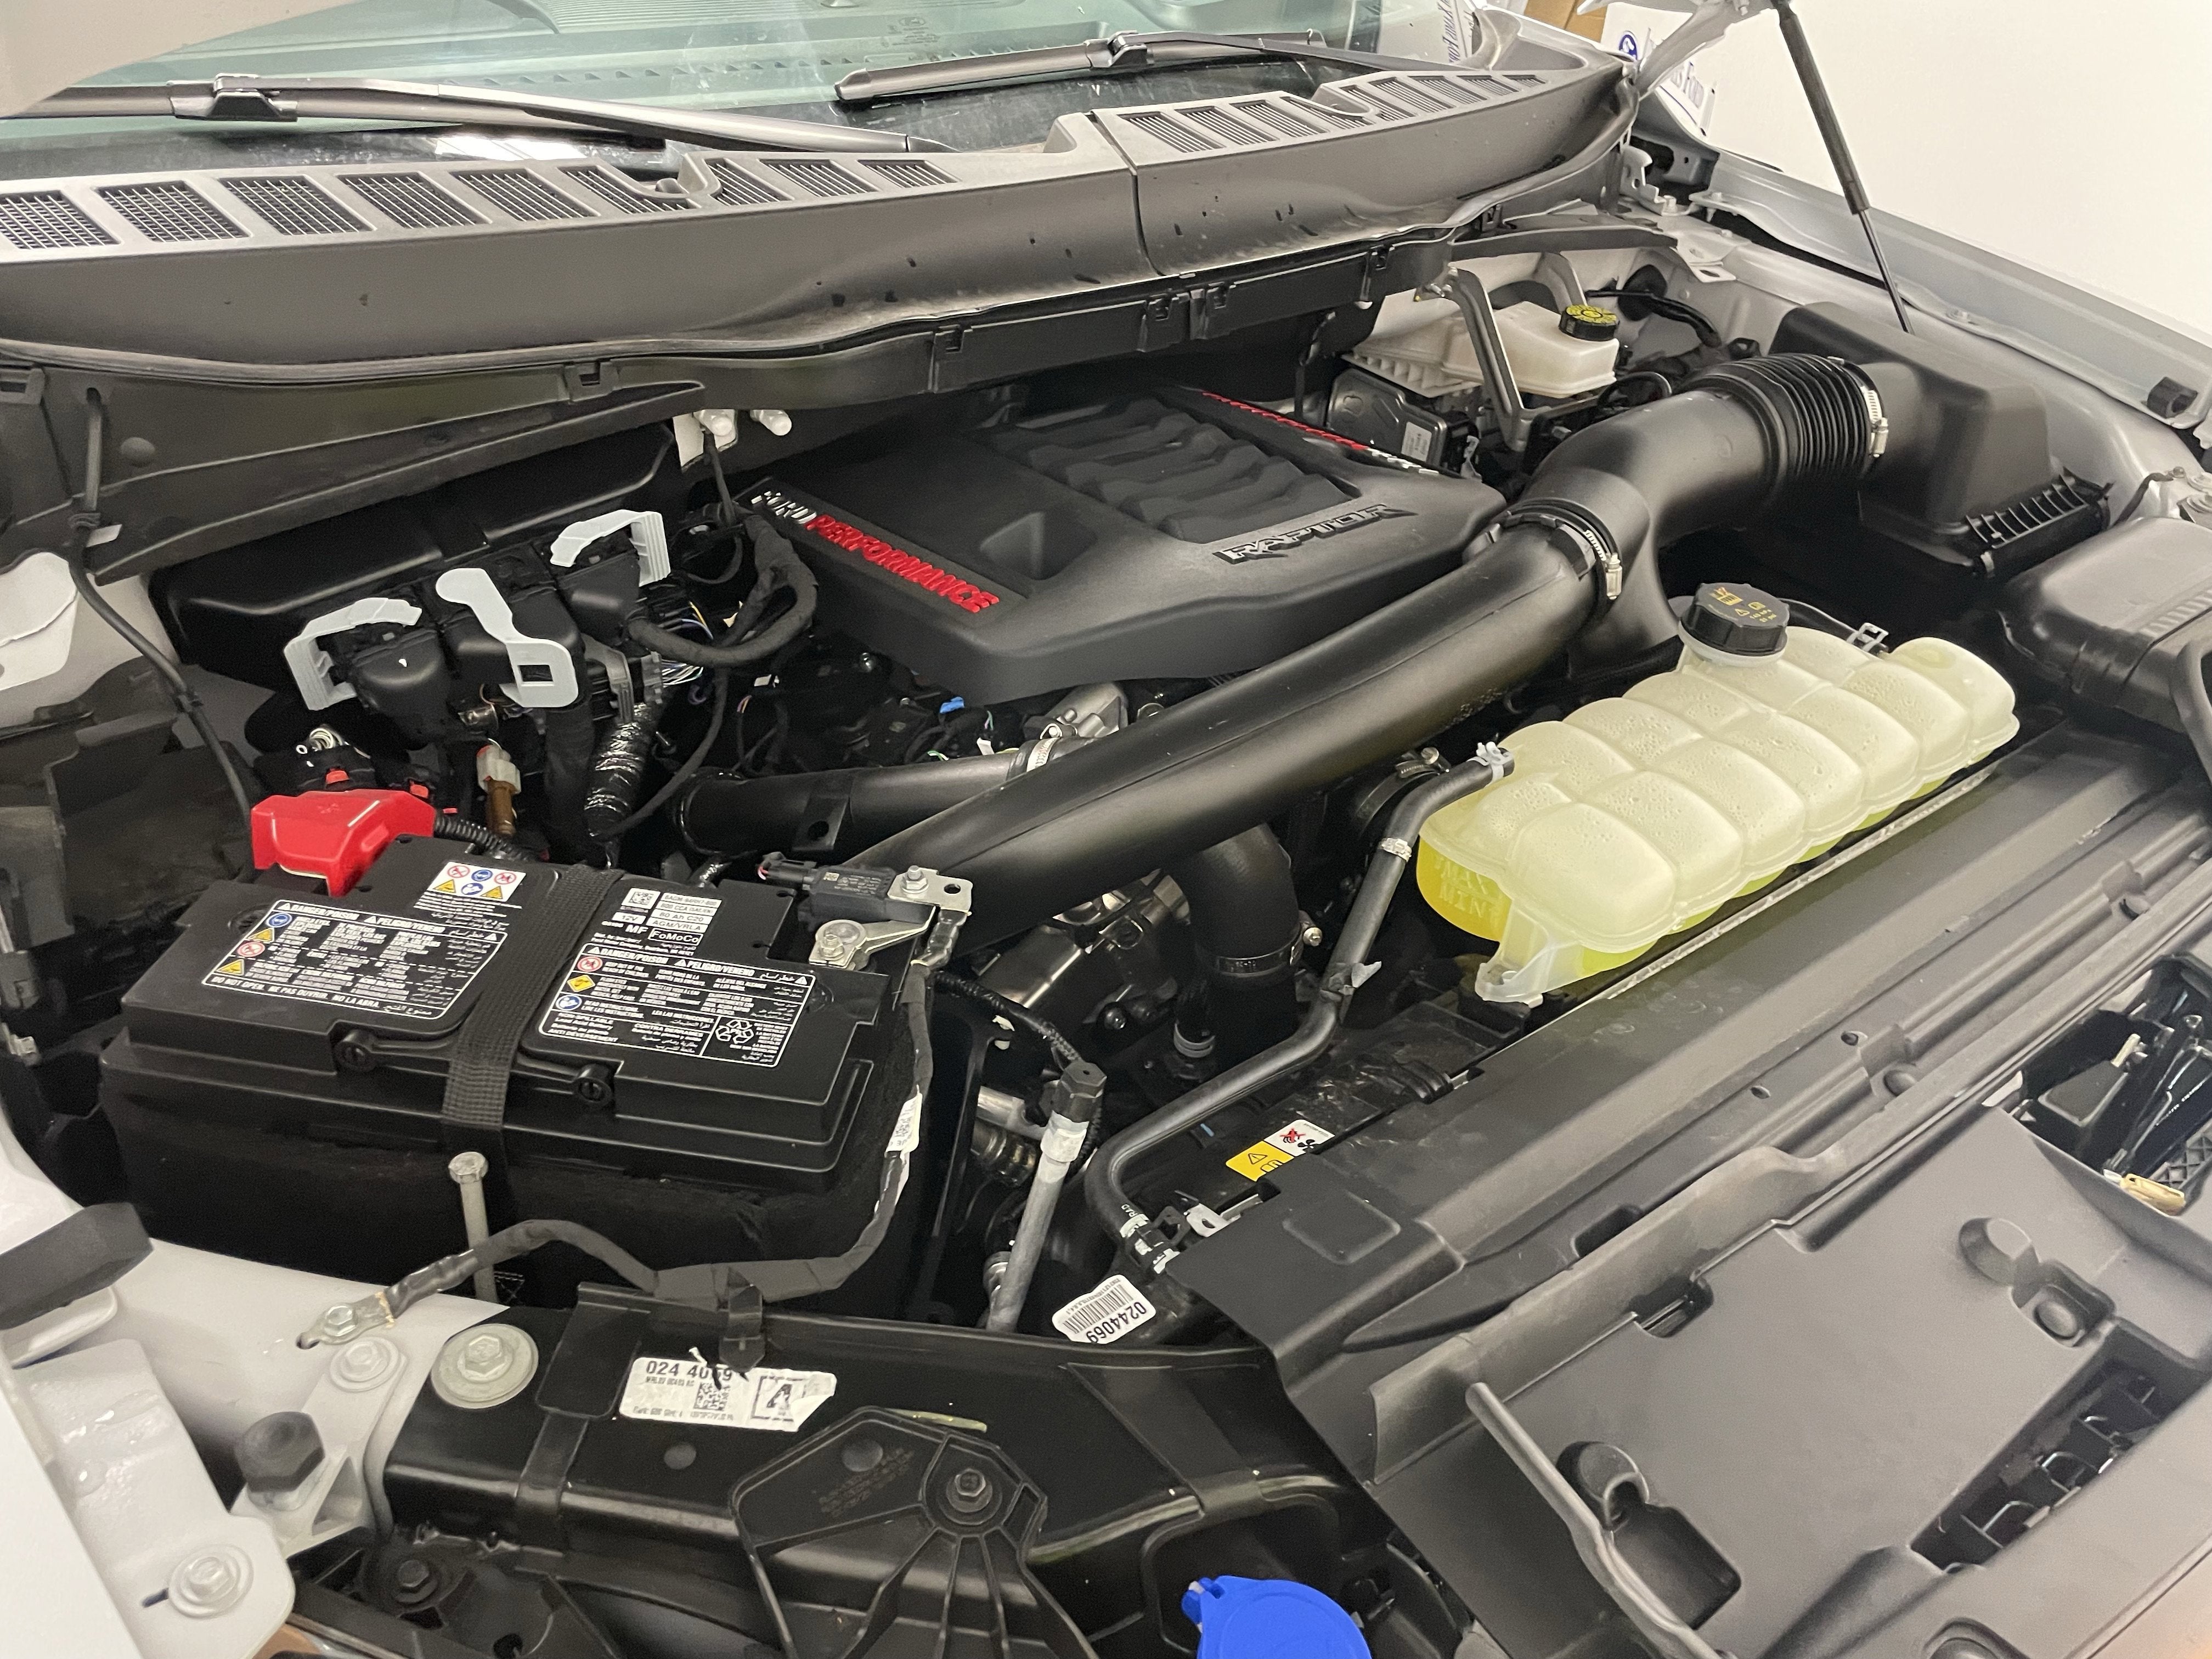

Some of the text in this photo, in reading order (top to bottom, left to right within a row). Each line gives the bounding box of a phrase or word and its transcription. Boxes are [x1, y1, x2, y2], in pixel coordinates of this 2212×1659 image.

[1212, 503, 1419, 565] RAPTOR
[751, 490, 1000, 613] FORD PERFORMANCE
[290, 904, 360, 921] DANGER/POISON
[625, 924, 649, 934] MF
[652, 920, 701, 931] AGM/VRLA
[651, 930, 699, 943] FoMoCo
[600, 947, 669, 964] DANGER/POISON
[686, 961, 755, 977] PELIGRO/VENENO
[634, 1023, 664, 1032] CONTRA
[1121, 1204, 1138, 1217] RAD
[1085, 1301, 1147, 1344] 0244069
[646, 1360, 733, 1381] 024 409
[766, 1383, 793, 1416] A
